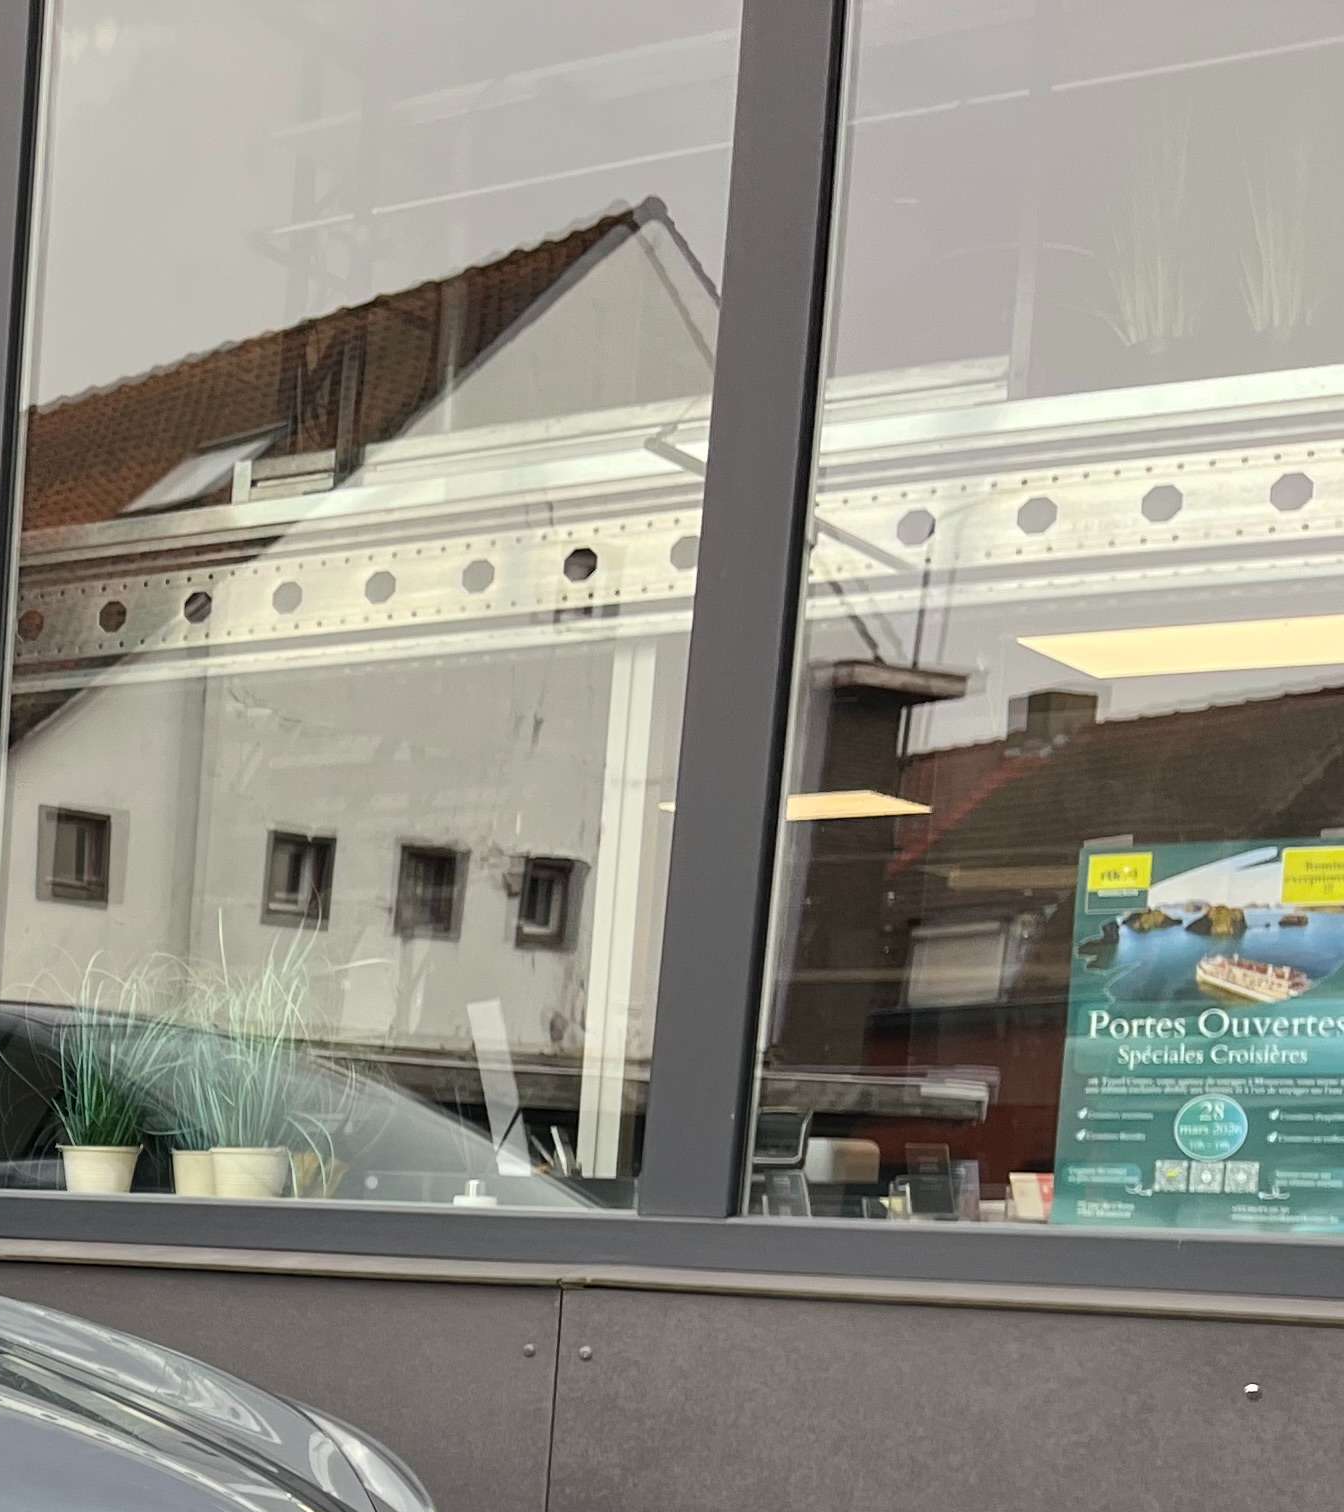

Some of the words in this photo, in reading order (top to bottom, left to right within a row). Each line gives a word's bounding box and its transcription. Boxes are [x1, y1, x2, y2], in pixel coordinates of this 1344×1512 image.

[1088, 1010, 1186, 1039] Portes
[1118, 1043, 1204, 1070] Spéciales
[1211, 1044, 1309, 1065] Croisières
